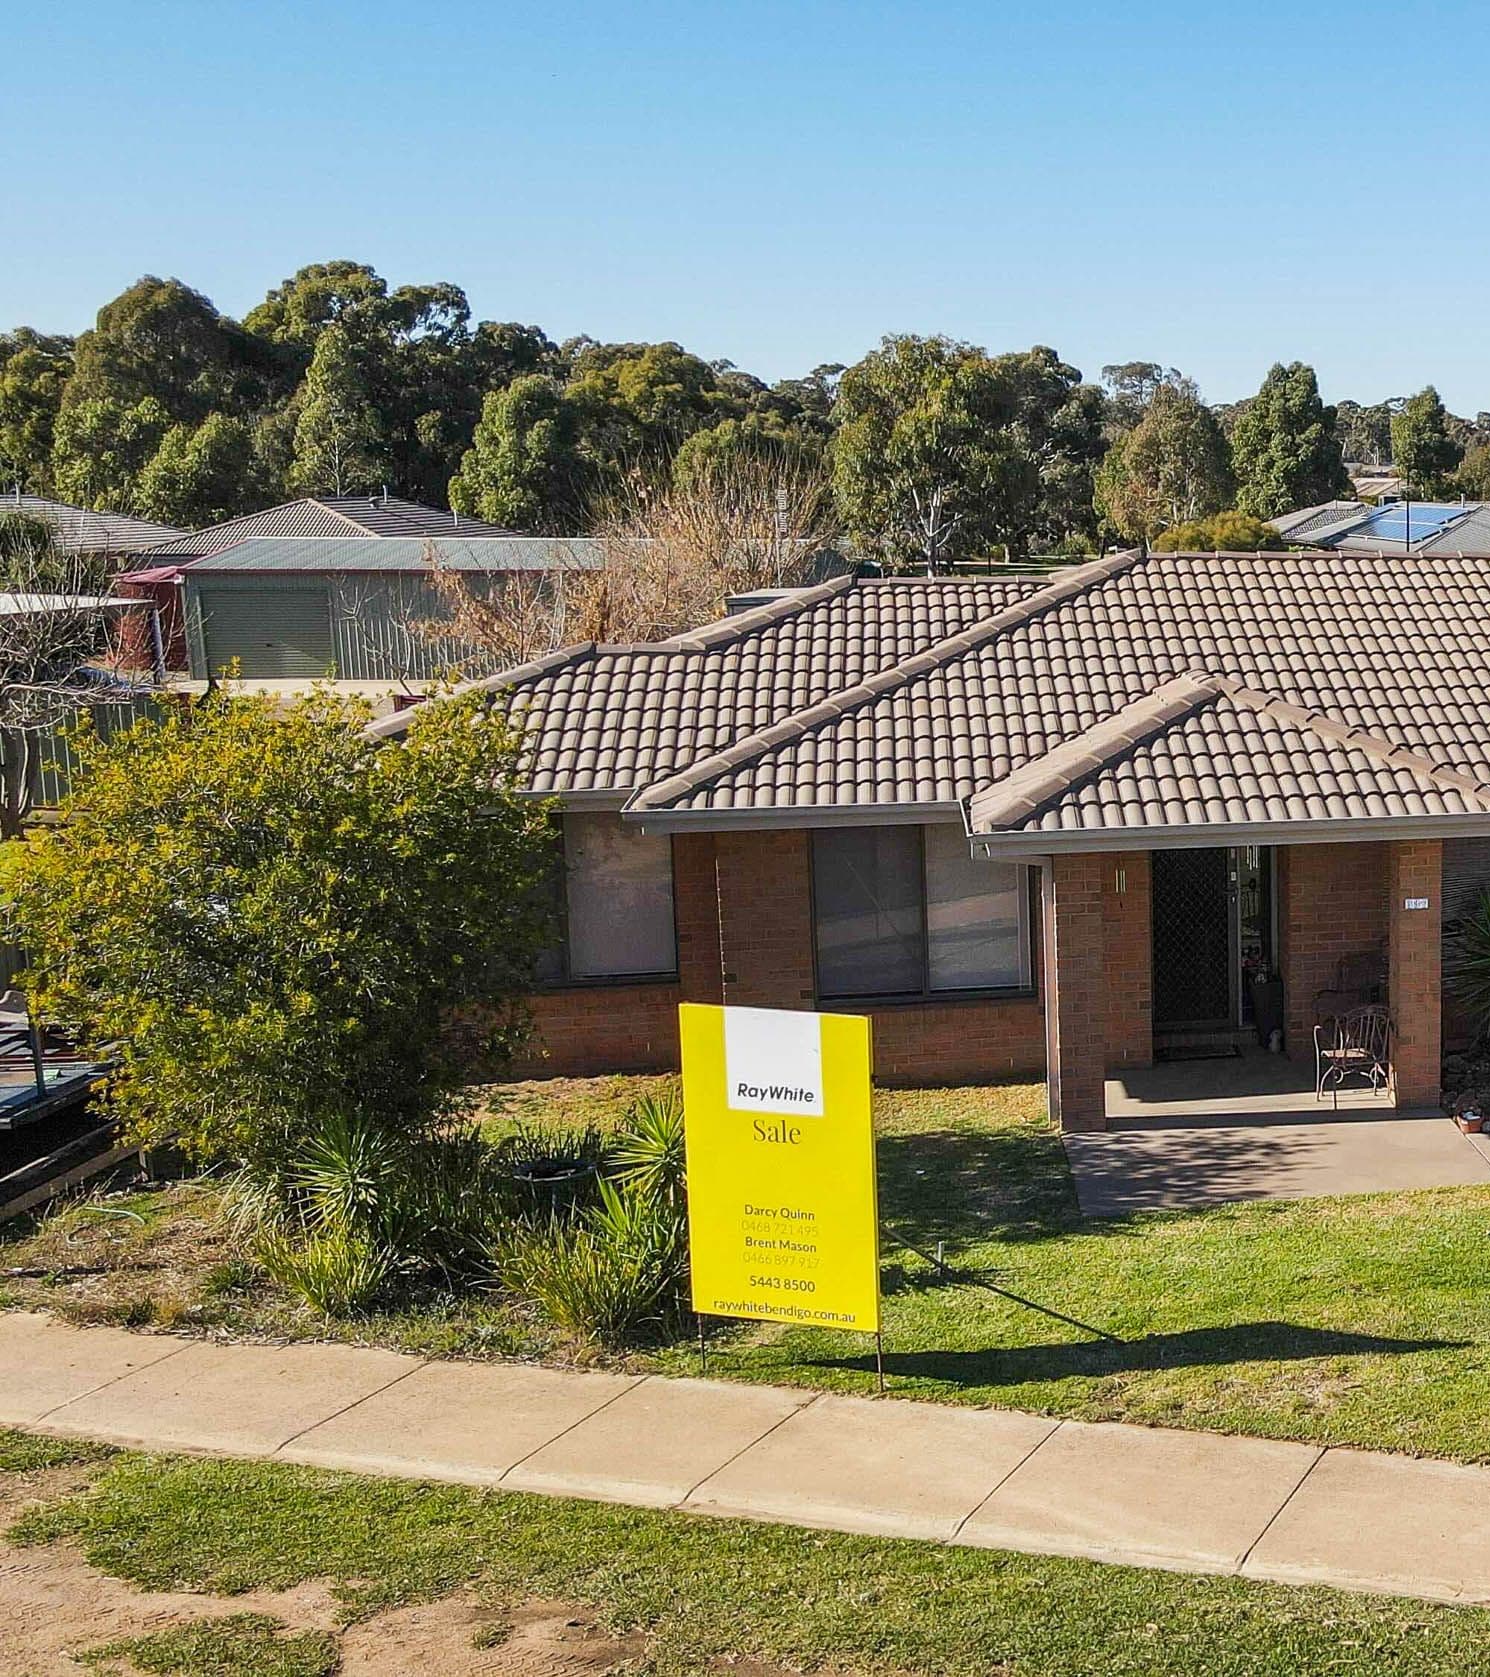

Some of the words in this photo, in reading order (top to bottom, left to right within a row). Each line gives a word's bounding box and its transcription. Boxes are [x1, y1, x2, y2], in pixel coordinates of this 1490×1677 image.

[737, 1083, 815, 1103] RayWhite
[753, 1118, 801, 1145] Sale
[744, 1204, 778, 1219] Darcy
[780, 1207, 816, 1221] Quinn
[741, 1220, 771, 1233] 0468
[745, 1236, 776, 1249] Brent
[779, 1239, 817, 1253] Mason
[749, 1275, 781, 1290] 5443
[783, 1277, 816, 1293] 8500
[713, 1298, 856, 1323] raywhitebendigo.com.au
